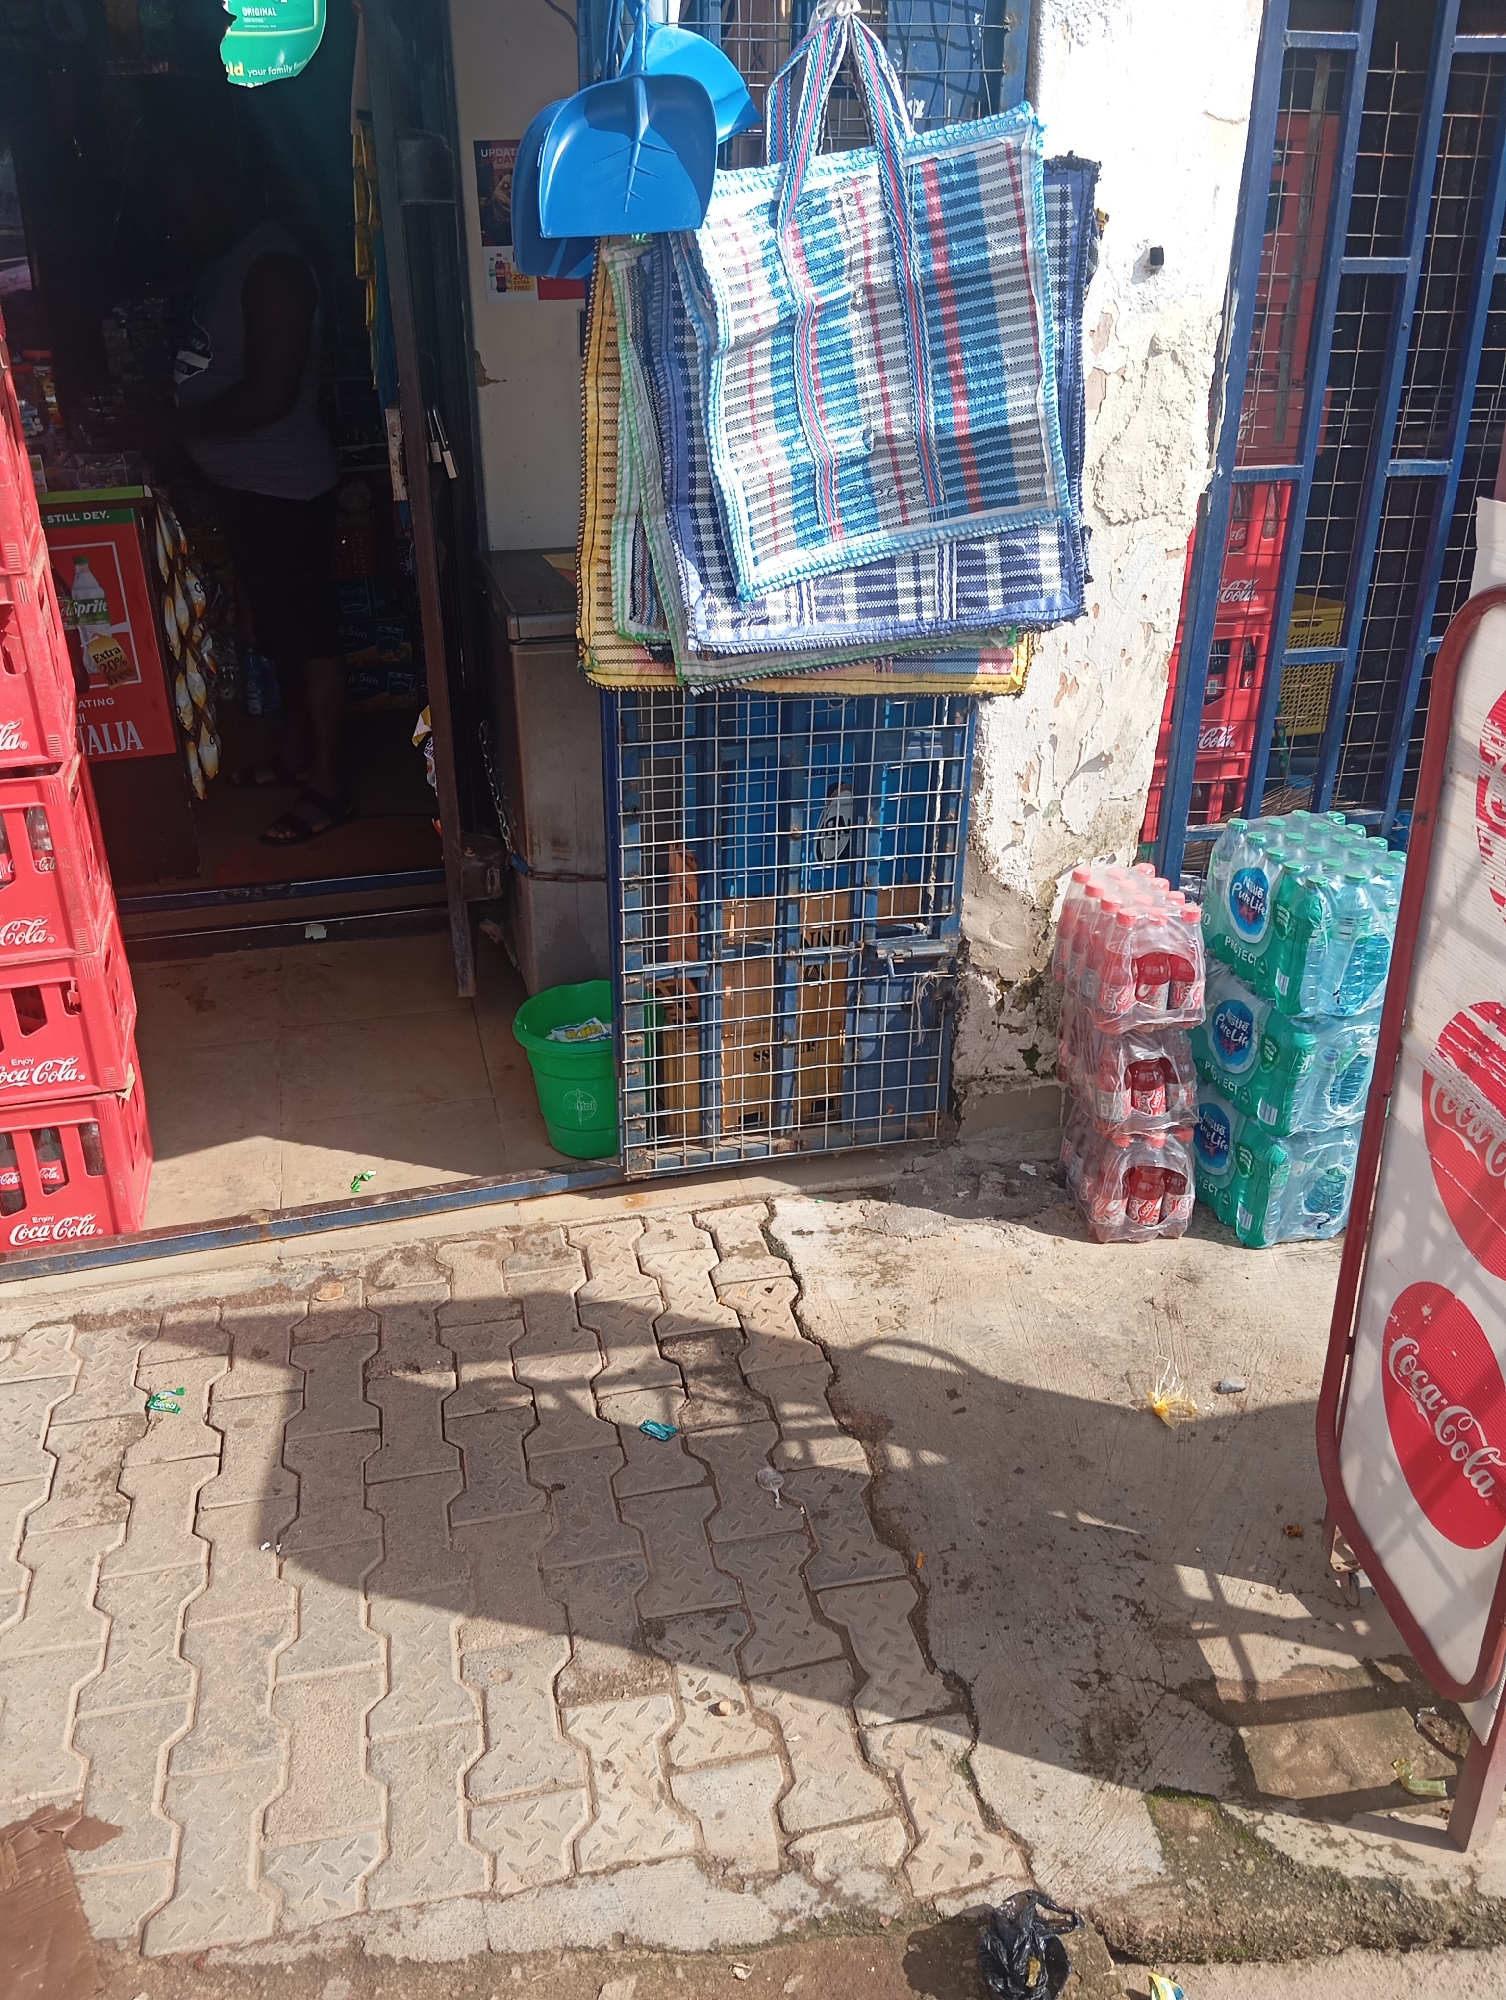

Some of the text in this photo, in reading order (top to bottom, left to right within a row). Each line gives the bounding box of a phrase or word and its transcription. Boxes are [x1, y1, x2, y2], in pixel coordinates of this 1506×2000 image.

[242, 7, 277, 17] ORIGINAL
[226, 61, 245, 77] ld
[247, 69, 267, 78] your
[268, 65, 293, 76] family
[47, 513, 80, 524] STILL
[83, 510, 110, 521] DEY.
[73, 600, 108, 618] Sprite
[337, 626, 368, 640] ri-Sun
[92, 646, 122, 664] Extra
[100, 655, 128, 675] 20%
[106, 669, 134, 686] free
[348, 672, 379, 686] ri-Sun
[78, 697, 115, 709] ATING
[1249, 898, 1267, 916] Life
[1224, 935, 1257, 967] PROTECT
[1230, 1029, 1249, 1048] Life
[11, 1058, 35, 1067] Enjoy
[1210, 1133, 1229, 1151] Life
[32, 1215, 55, 1224] Enjoy
[9, 1213, 97, 1246] Coca-Cola
[1388, 1337, 1506, 1499] Coca-Cola
